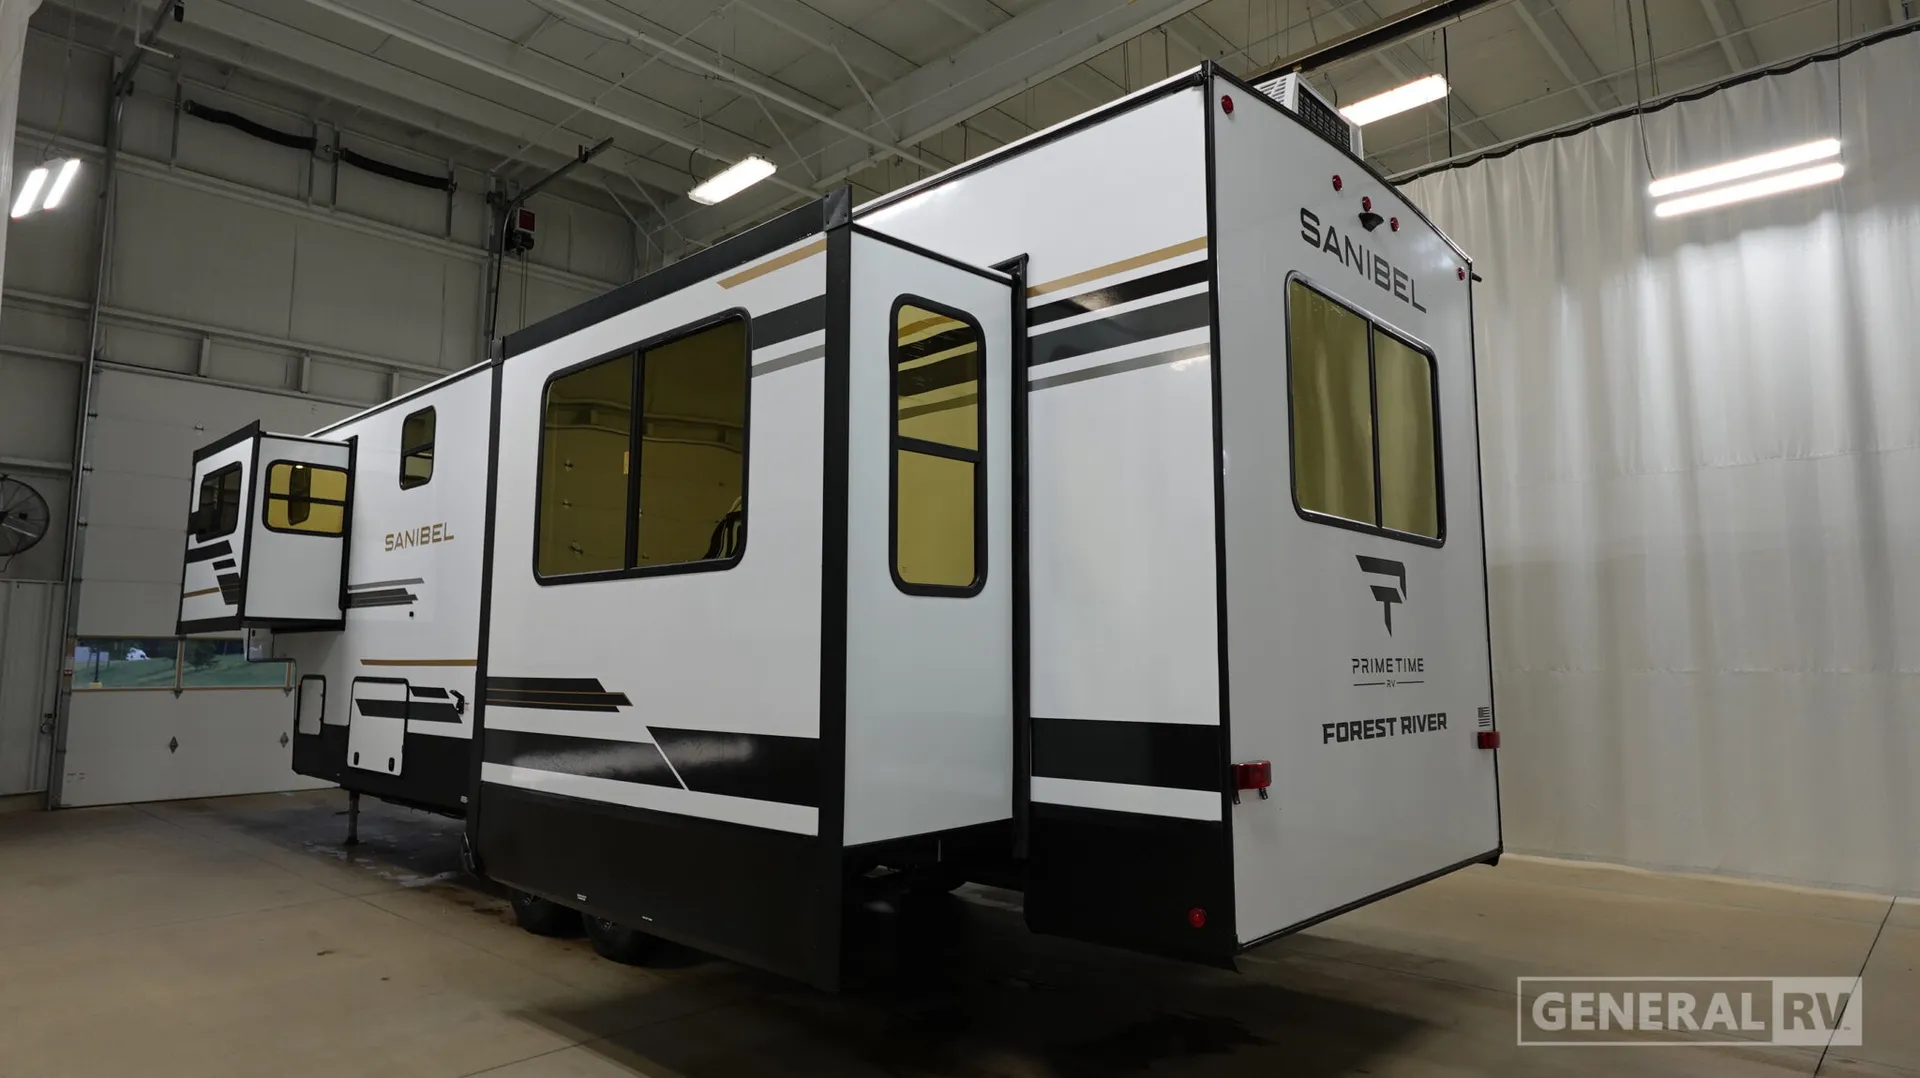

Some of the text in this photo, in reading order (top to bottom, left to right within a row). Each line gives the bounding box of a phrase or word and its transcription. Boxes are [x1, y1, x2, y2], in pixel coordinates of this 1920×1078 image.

[1300, 207, 1427, 314] SANIBEL
[384, 521, 455, 552] SANIBEL
[1386, 679, 1396, 688] RV
[1322, 712, 1447, 744] FOREST RIVER
